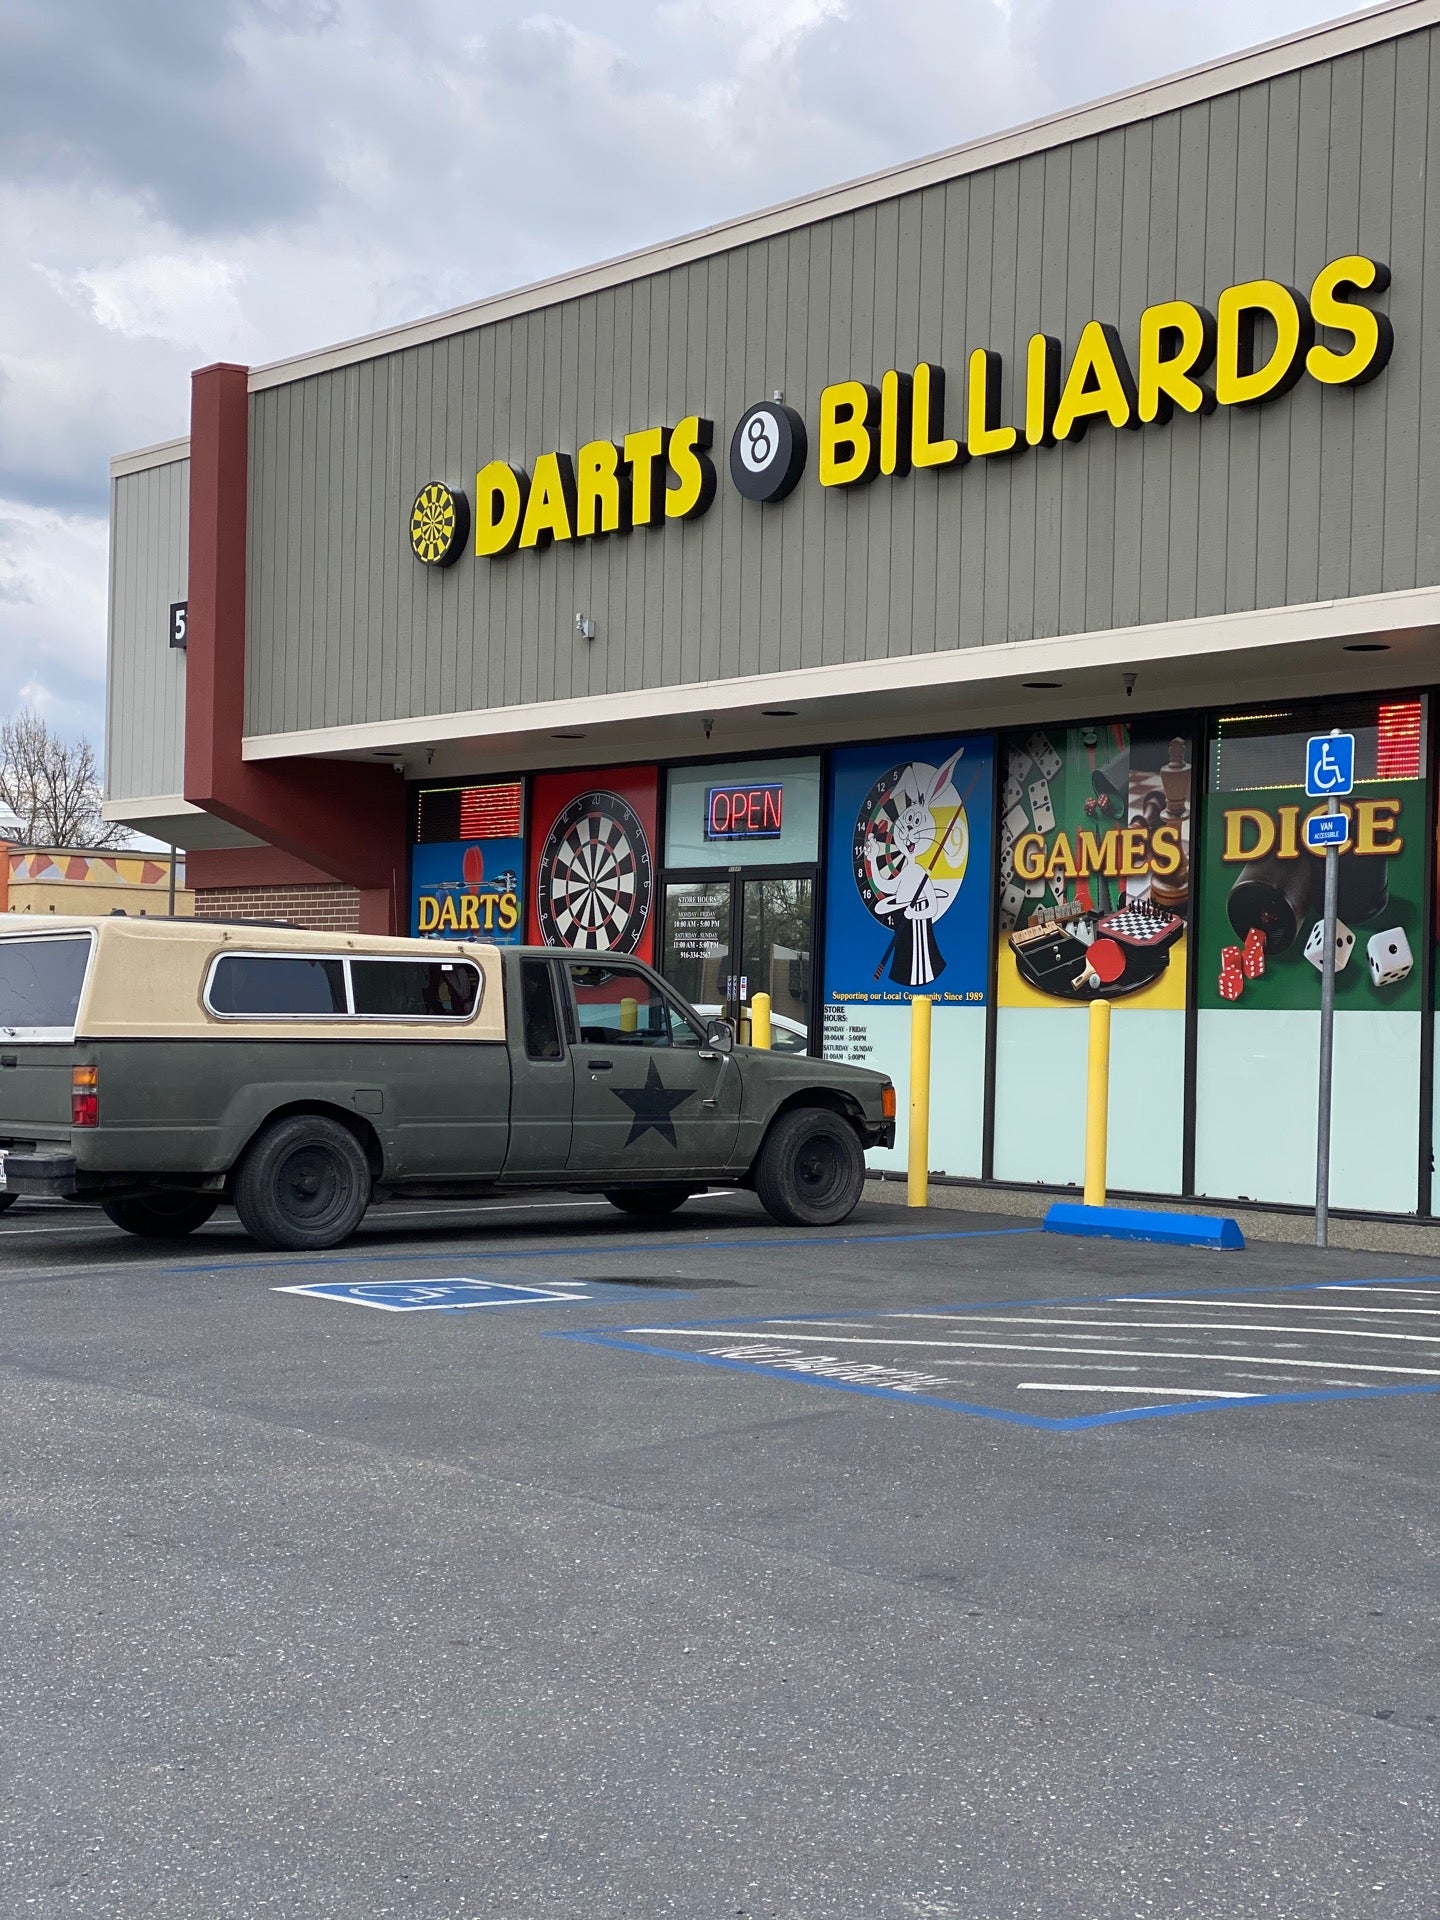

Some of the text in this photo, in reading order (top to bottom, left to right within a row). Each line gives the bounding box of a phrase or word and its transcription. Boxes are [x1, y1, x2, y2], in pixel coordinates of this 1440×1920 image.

[819, 255, 1393, 488] BILLIARDS
[747, 417, 771, 464] 8
[475, 415, 716, 558] DARTS
[175, 609, 187, 640] 5
[893, 771, 898, 781] 5
[877, 782, 886, 792] 12
[712, 789, 783, 831] OPEN
[867, 800, 872, 810] 9
[857, 822, 866, 831] 14
[1222, 799, 1403, 861] DICE
[1320, 821, 1333, 832] VAN
[1314, 830, 1339, 839] ACCESSIBLE
[1013, 825, 1182, 880] GAMES
[858, 868, 863, 878] 8
[863, 889, 872, 899] 16
[679, 896, 717, 904] STORE HOURS
[418, 892, 518, 931] DARTS
[687, 920, 696, 928] AM
[700, 920, 710, 928] 5:00
[711, 920, 720, 928] PM
[686, 941, 696, 949] AM
[709, 941, 719, 949] PM
[832, 990, 868, 1002] Supporting
[883, 991, 902, 1000] Local
[944, 991, 962, 1001] Since
[965, 991, 984, 1001] 1989
[824, 1006, 845, 1014] STORE
[824, 1014, 848, 1022] HOURS:
[823, 1044, 849, 1052] SATURDAY
